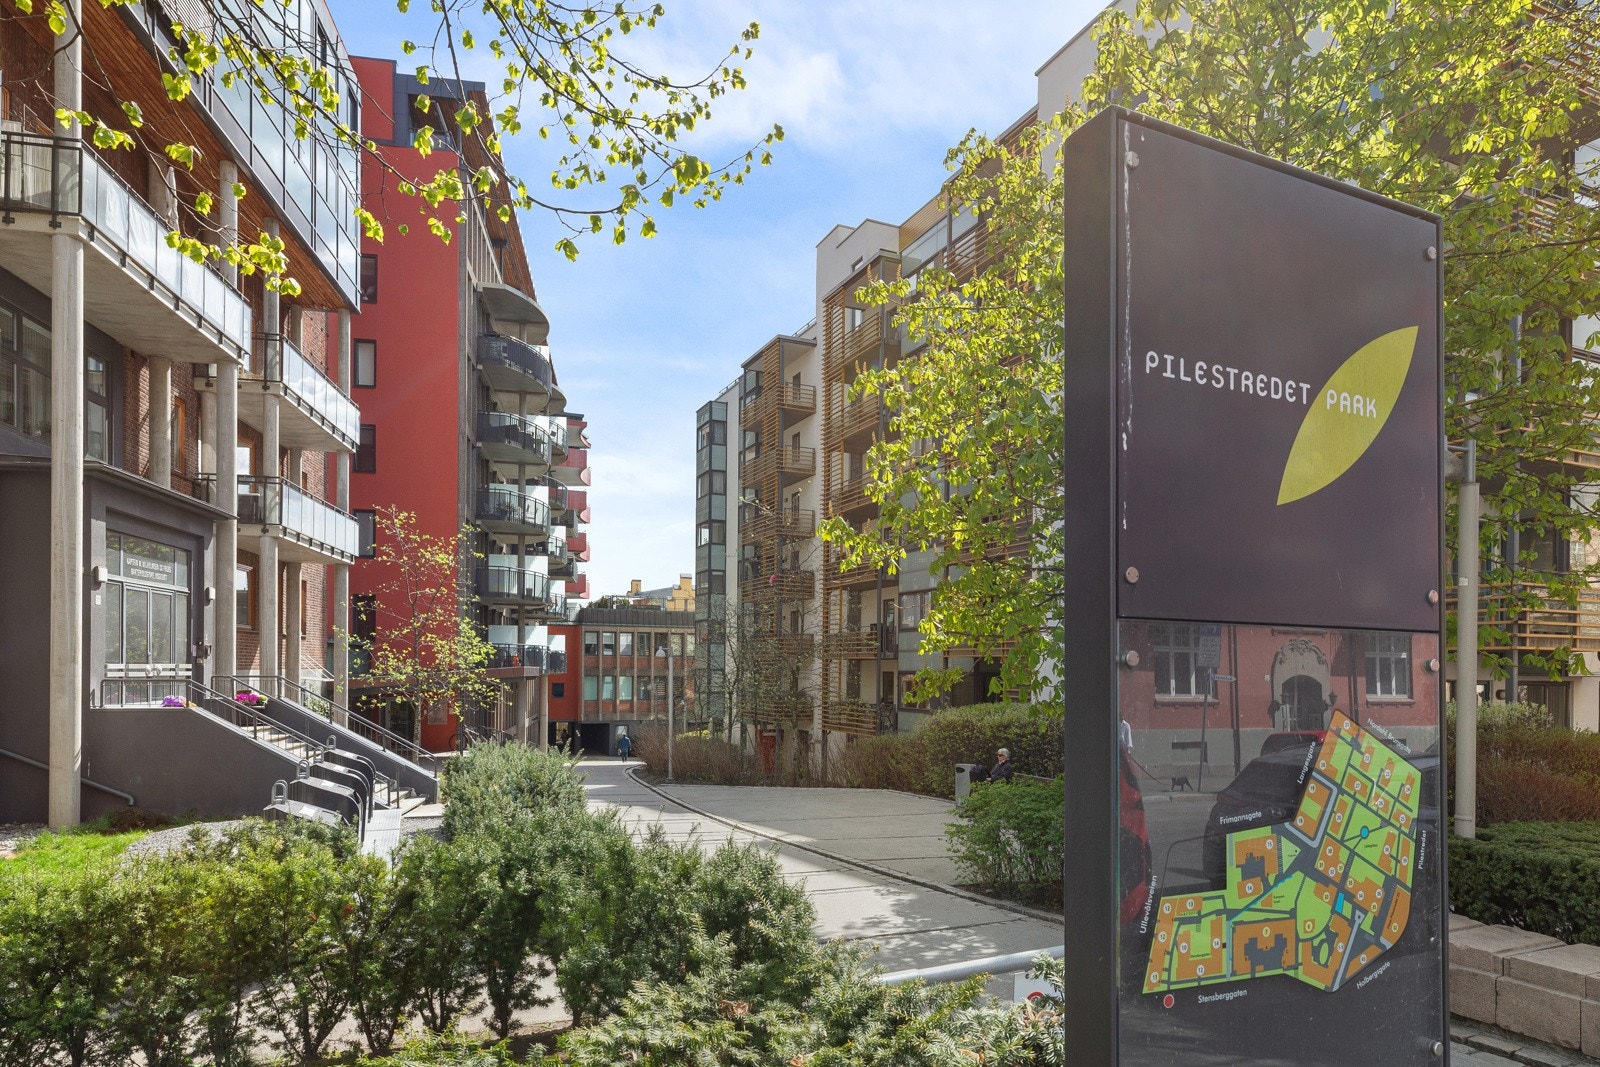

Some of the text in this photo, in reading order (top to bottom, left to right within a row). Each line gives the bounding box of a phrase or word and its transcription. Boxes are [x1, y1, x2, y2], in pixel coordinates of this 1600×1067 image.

[1146, 350, 1377, 418] PILESTREDET PARK
[1297, 741, 1316, 784] Langesgate
[1220, 811, 1262, 824] Frimannsgate
[1418, 830, 1426, 869] Pilestredet
[1139, 875, 1157, 934] Ullevålsveien
[1356, 961, 1391, 989] Holbergsgate
[1198, 988, 1248, 1004] Stensberggaten
